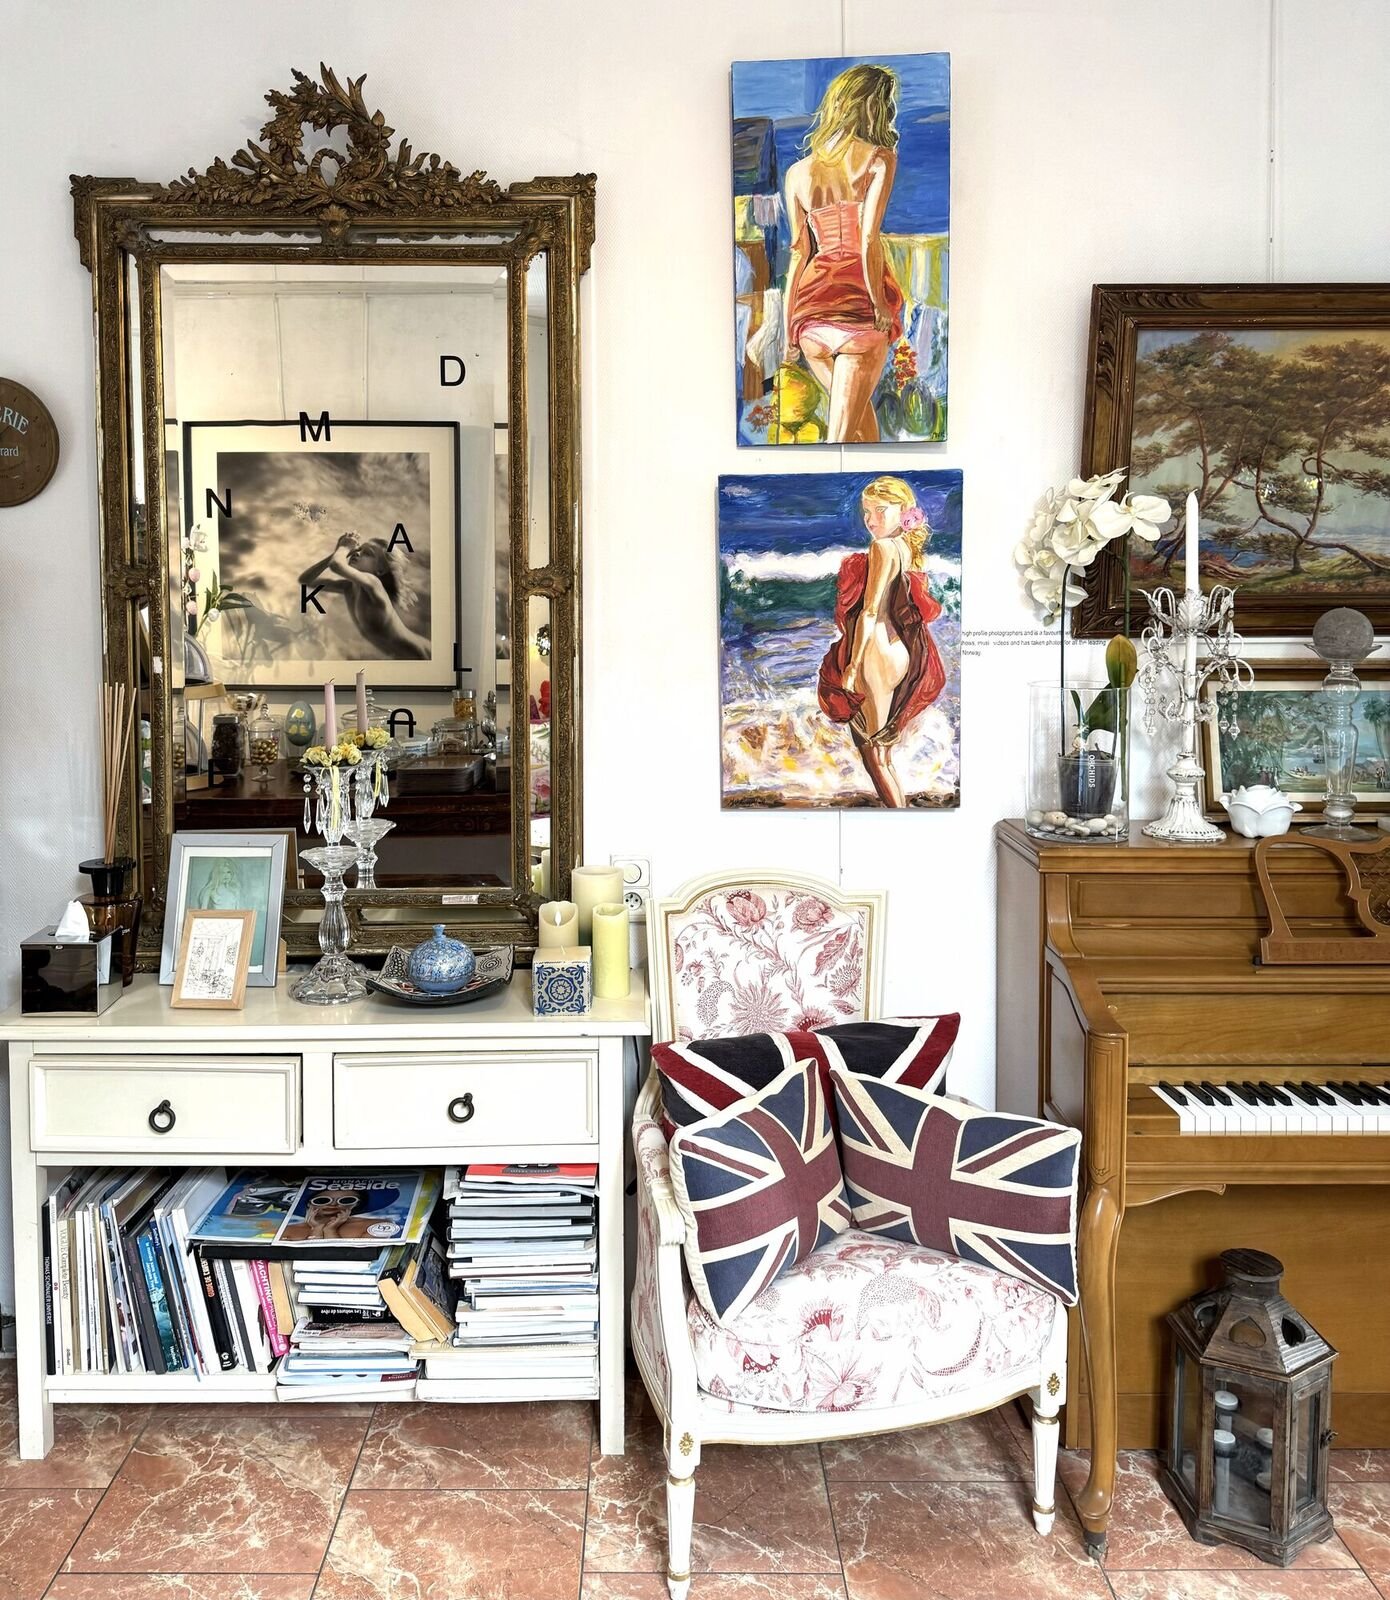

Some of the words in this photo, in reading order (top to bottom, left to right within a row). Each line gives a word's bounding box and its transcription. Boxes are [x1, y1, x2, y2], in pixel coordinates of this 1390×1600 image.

[440, 355, 466, 387] D
[299, 411, 332, 442] M
[206, 488, 232, 519] N
[386, 523, 414, 553] A
[301, 585, 327, 614] K
[453, 643, 472, 672] L
[308, 1180, 401, 1191] Seaside
